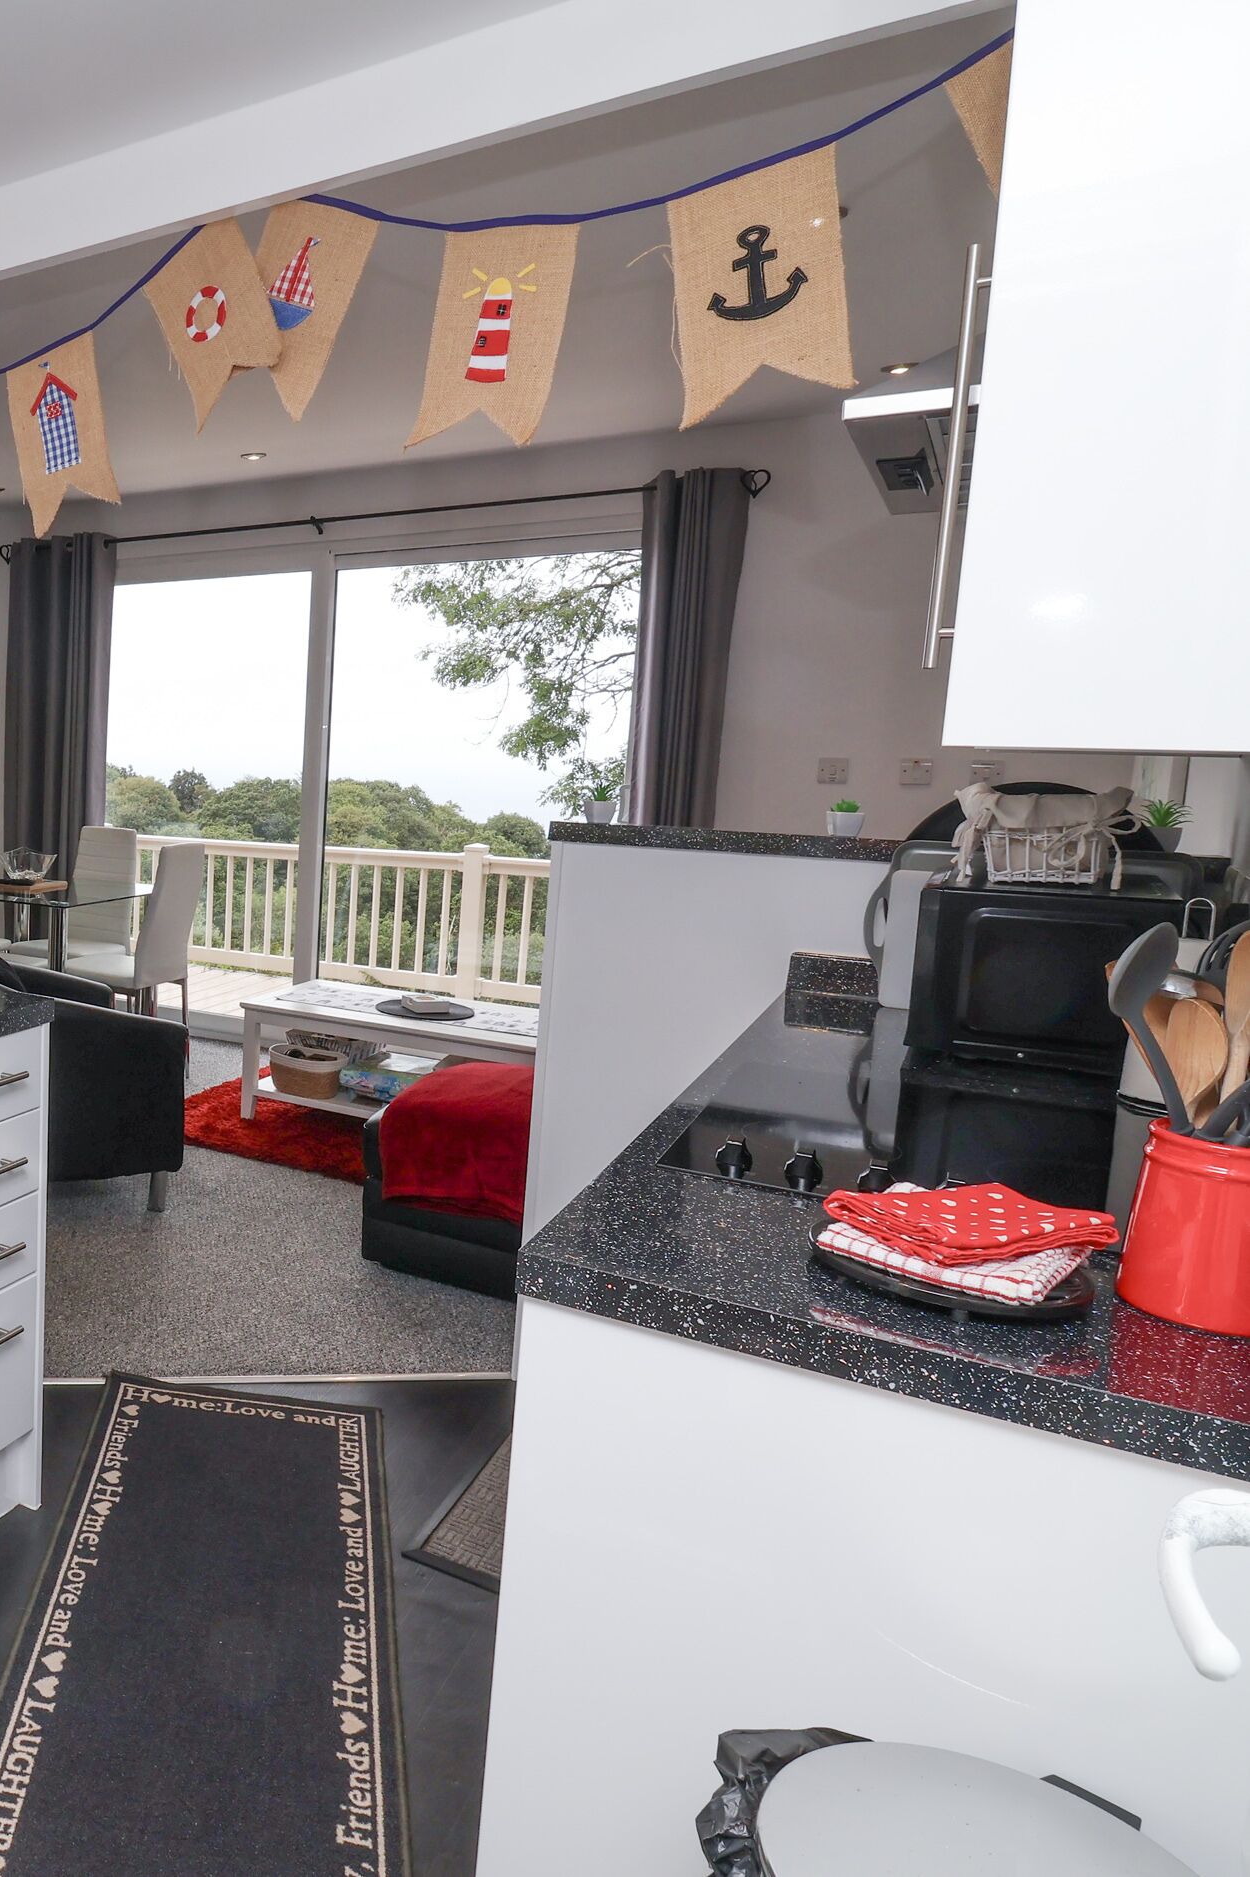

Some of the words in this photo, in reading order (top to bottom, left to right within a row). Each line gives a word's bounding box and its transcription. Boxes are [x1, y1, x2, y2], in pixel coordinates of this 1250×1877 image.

[103, 1417, 140, 1470] Friends
[293, 1412, 337, 1427] and
[337, 1417, 362, 1492] LAUGHTER
[338, 1525, 364, 1558] and
[58, 1554, 99, 1606] Love
[337, 1560, 367, 1613] Love
[44, 1608, 72, 1649] and
[335, 1737, 374, 1850] Friends
